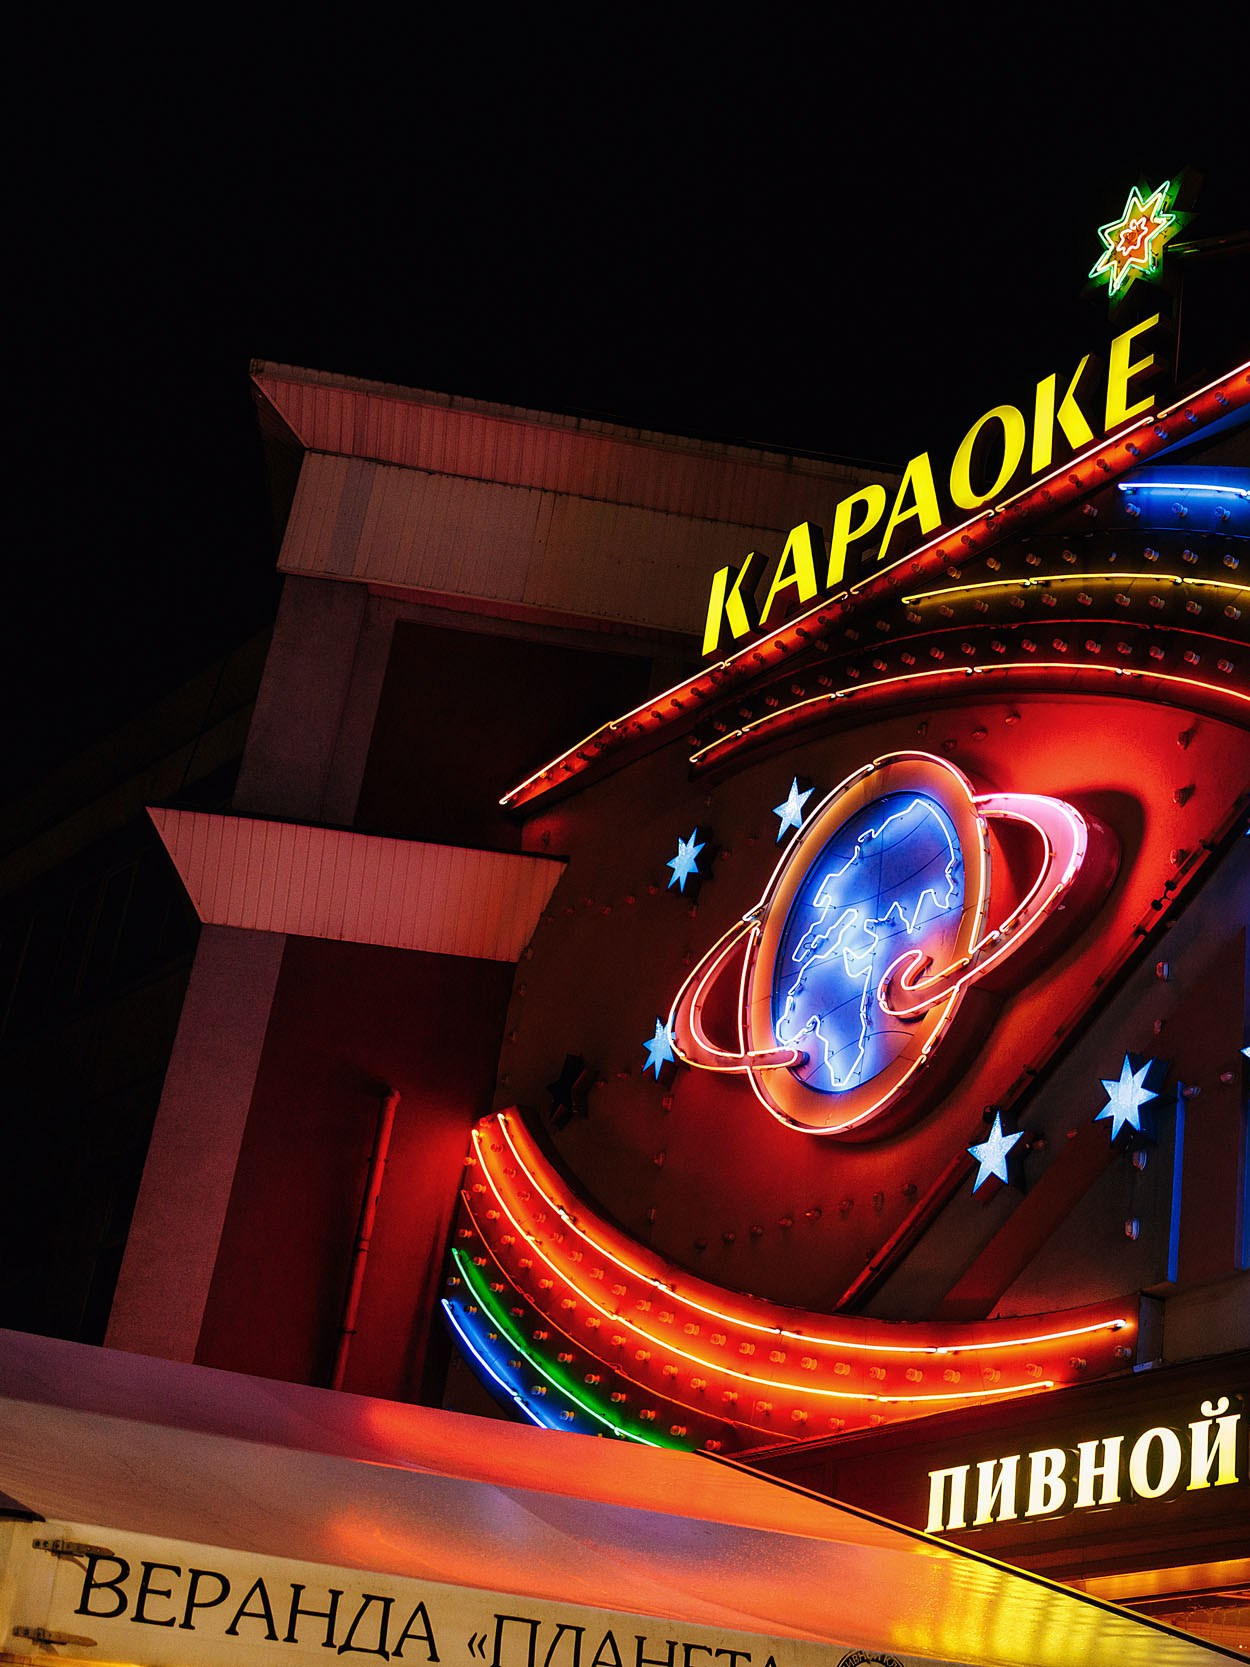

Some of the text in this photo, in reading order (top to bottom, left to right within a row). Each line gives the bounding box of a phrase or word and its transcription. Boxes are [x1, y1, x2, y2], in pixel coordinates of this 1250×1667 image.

[701, 312, 1160, 657] КАРАОКЕ
[923, 1396, 1241, 1533] ПИВНОЙ
[74, 1553, 780, 1667] ВЕРАНДА «ПЛАН
